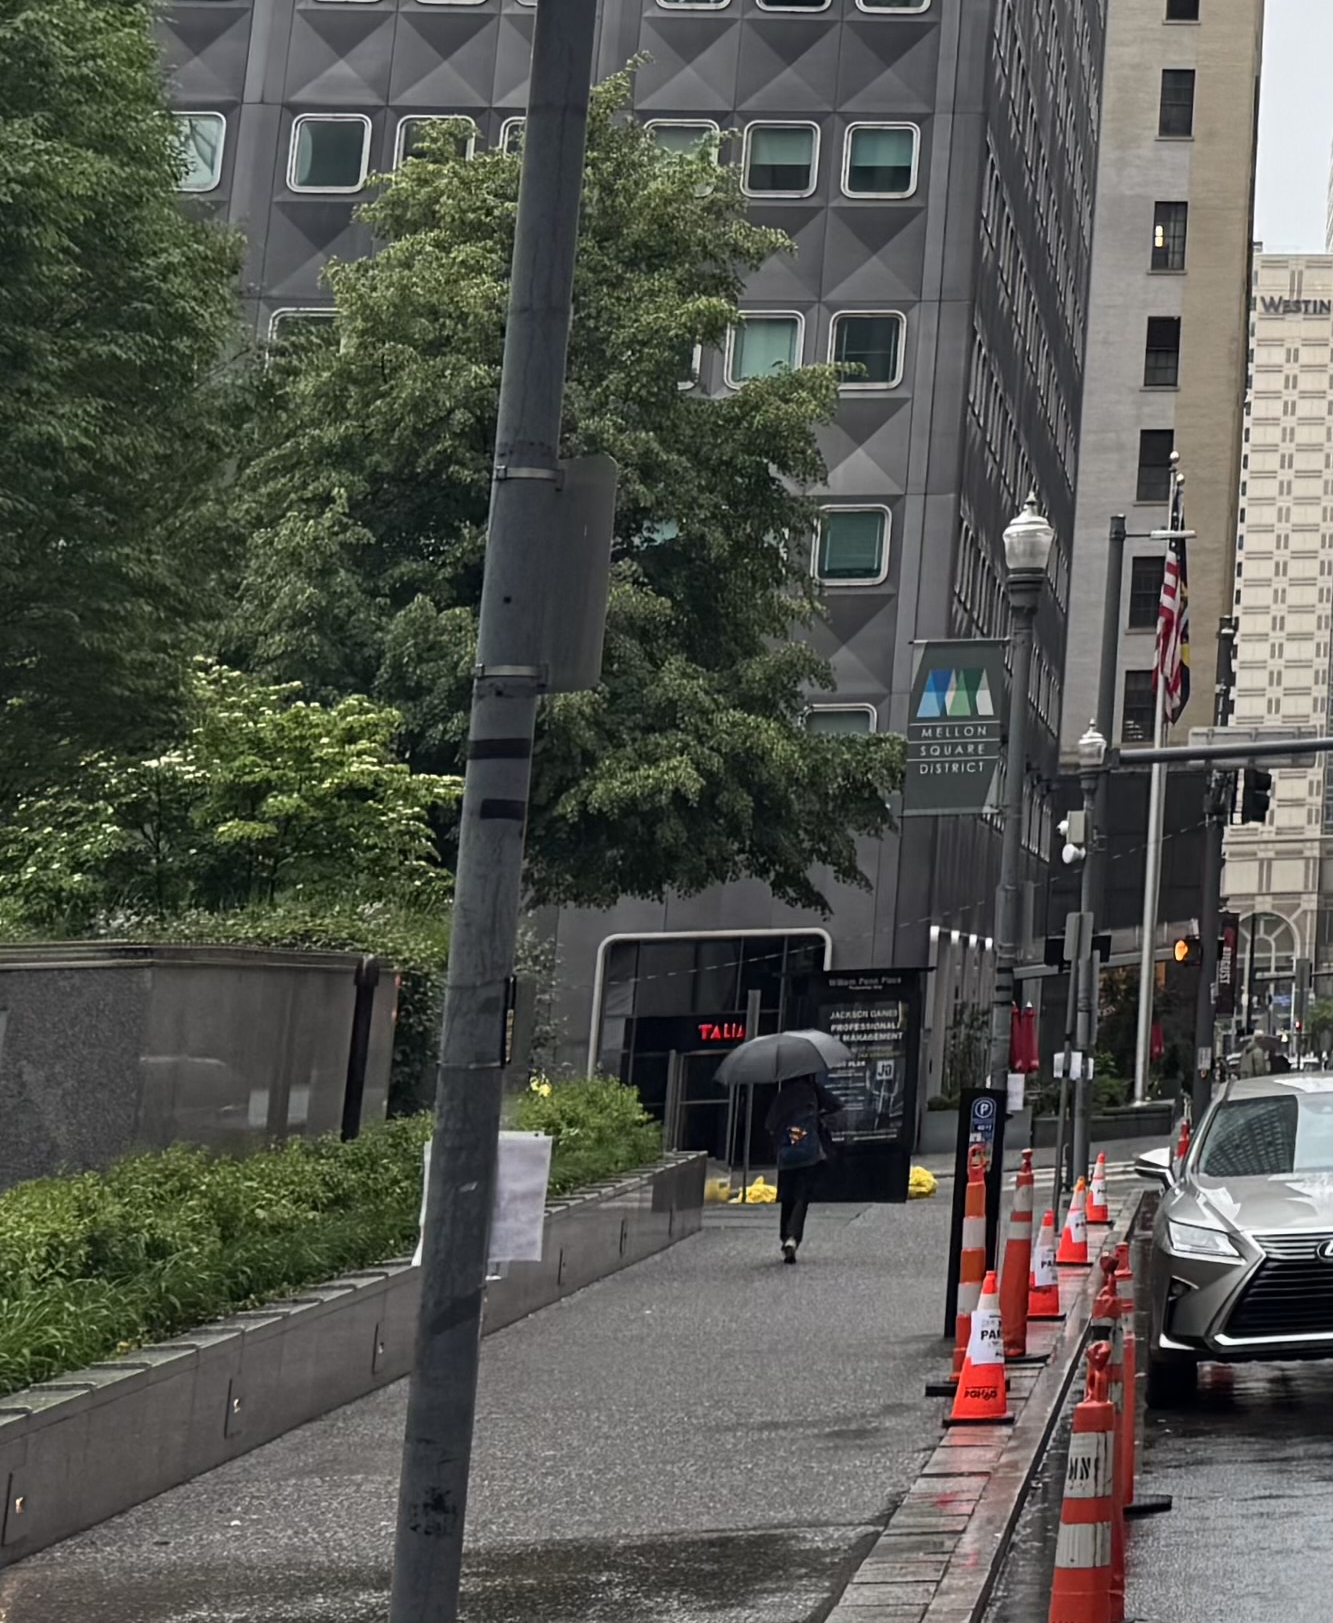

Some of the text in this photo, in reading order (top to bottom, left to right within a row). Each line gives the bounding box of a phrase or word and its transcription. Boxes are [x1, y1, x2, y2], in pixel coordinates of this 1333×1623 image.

[921, 725, 987, 738] MELLON
[919, 743, 985, 757] SQUARE
[919, 761, 985, 775] DISTRICT
